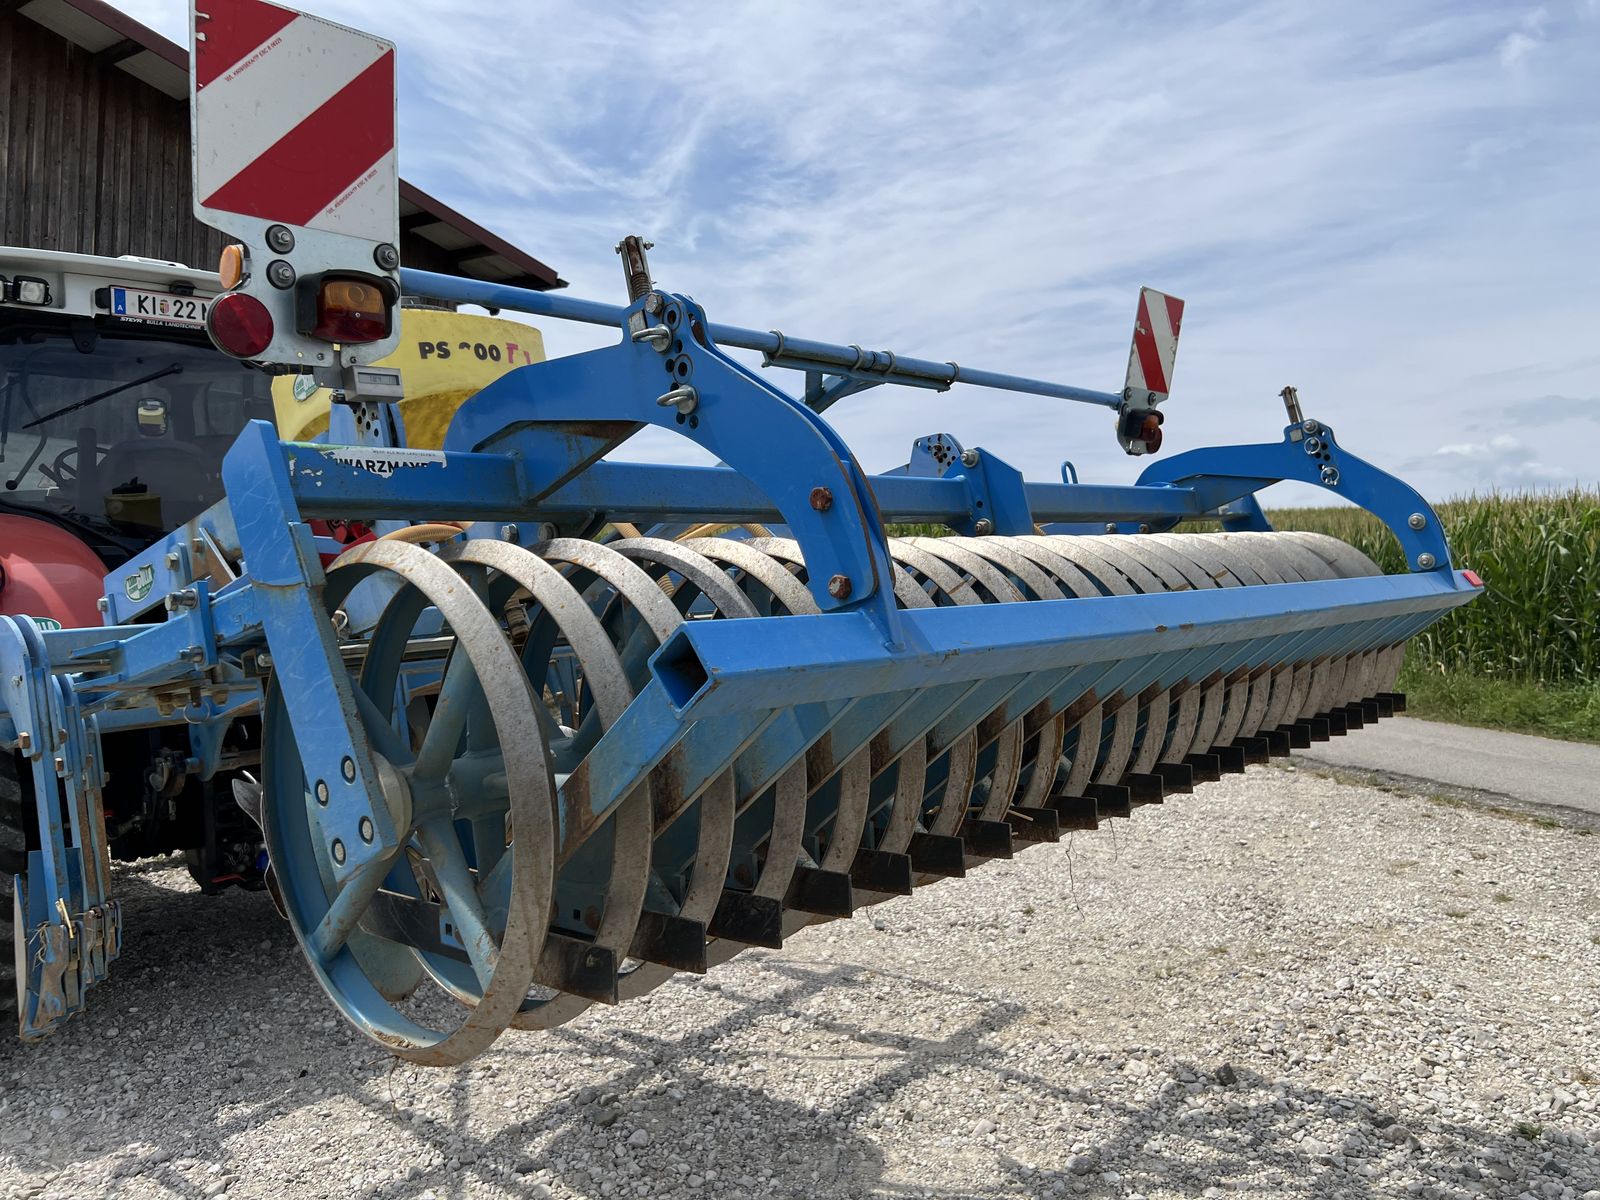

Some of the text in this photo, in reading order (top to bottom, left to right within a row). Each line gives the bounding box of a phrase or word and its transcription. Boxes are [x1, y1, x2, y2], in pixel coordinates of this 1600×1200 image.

[117, 304, 124, 312] A
[138, 294, 156, 315] KI
[120, 316, 142, 324] STEYR
[418, 341, 451, 360] PS
